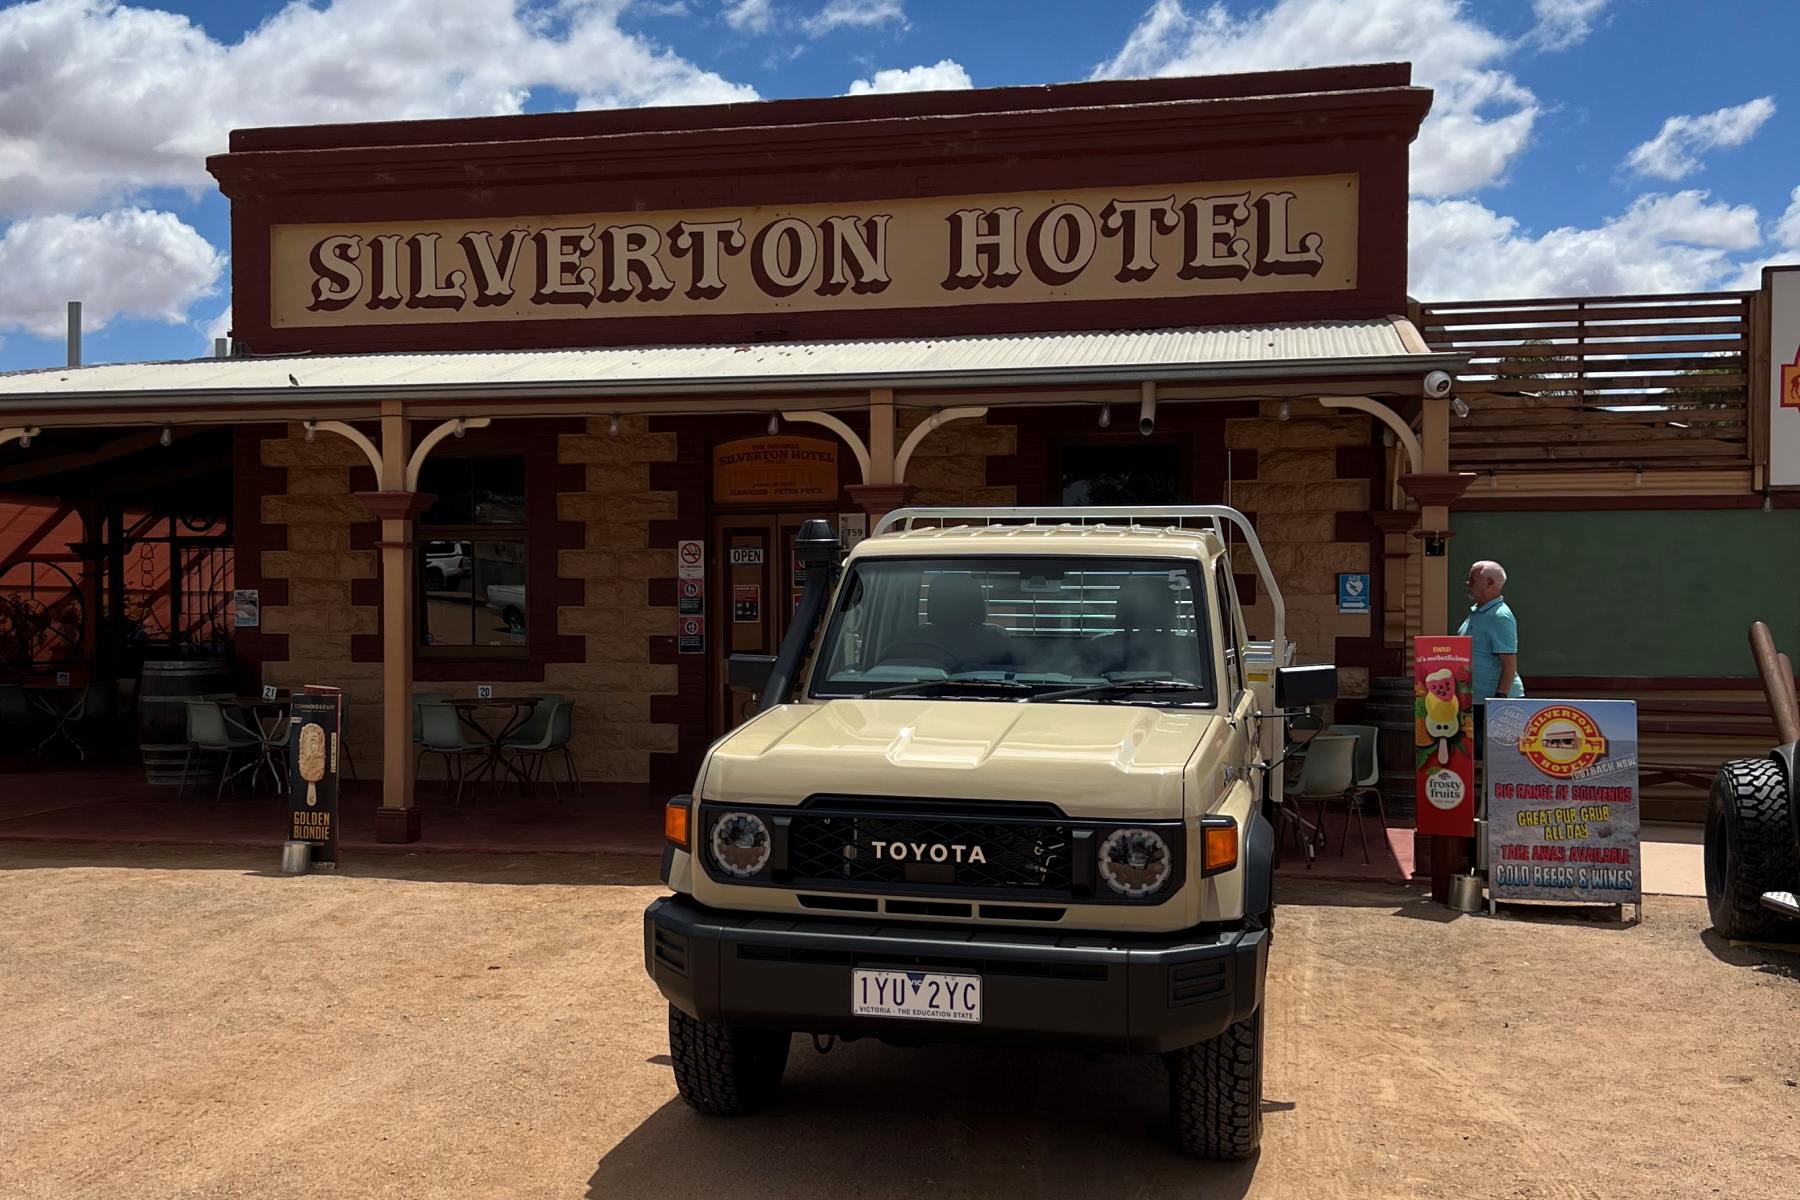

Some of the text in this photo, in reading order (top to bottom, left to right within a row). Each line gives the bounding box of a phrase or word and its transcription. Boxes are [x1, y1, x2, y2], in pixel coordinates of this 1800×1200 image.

[305, 190, 1324, 312] SILVERTON HOTEL
[719, 450, 834, 466] SILVERTON HOTEL
[733, 550, 760, 562] OPEN
[265, 687, 275, 697] 21
[480, 687, 490, 697] 20
[1529, 709, 1594, 734] SILVERTON
[1540, 759, 1588, 773] HOTEL
[1429, 778, 1461, 791] frosty
[1516, 784, 1553, 800] RANGE
[1556, 784, 1569, 800] OF
[1431, 788, 1461, 799] fruits
[293, 811, 330, 826] GOLDEN
[1517, 804, 1610, 826] GREAT PUB GRUB
[293, 825, 330, 840] BLONDIE
[1544, 824, 1589, 840] ALL DAY
[871, 841, 987, 864] TOYOTA
[1502, 844, 1529, 861] TAKE
[1569, 847, 1630, 864] AVAILABLE
[1496, 864, 1633, 890] COLD BEERS & WINES
[861, 977, 976, 1011] 1YU 2YC
[859, 1006, 891, 1014] VICTORIA
[912, 1009, 951, 1018] EDUCATION
